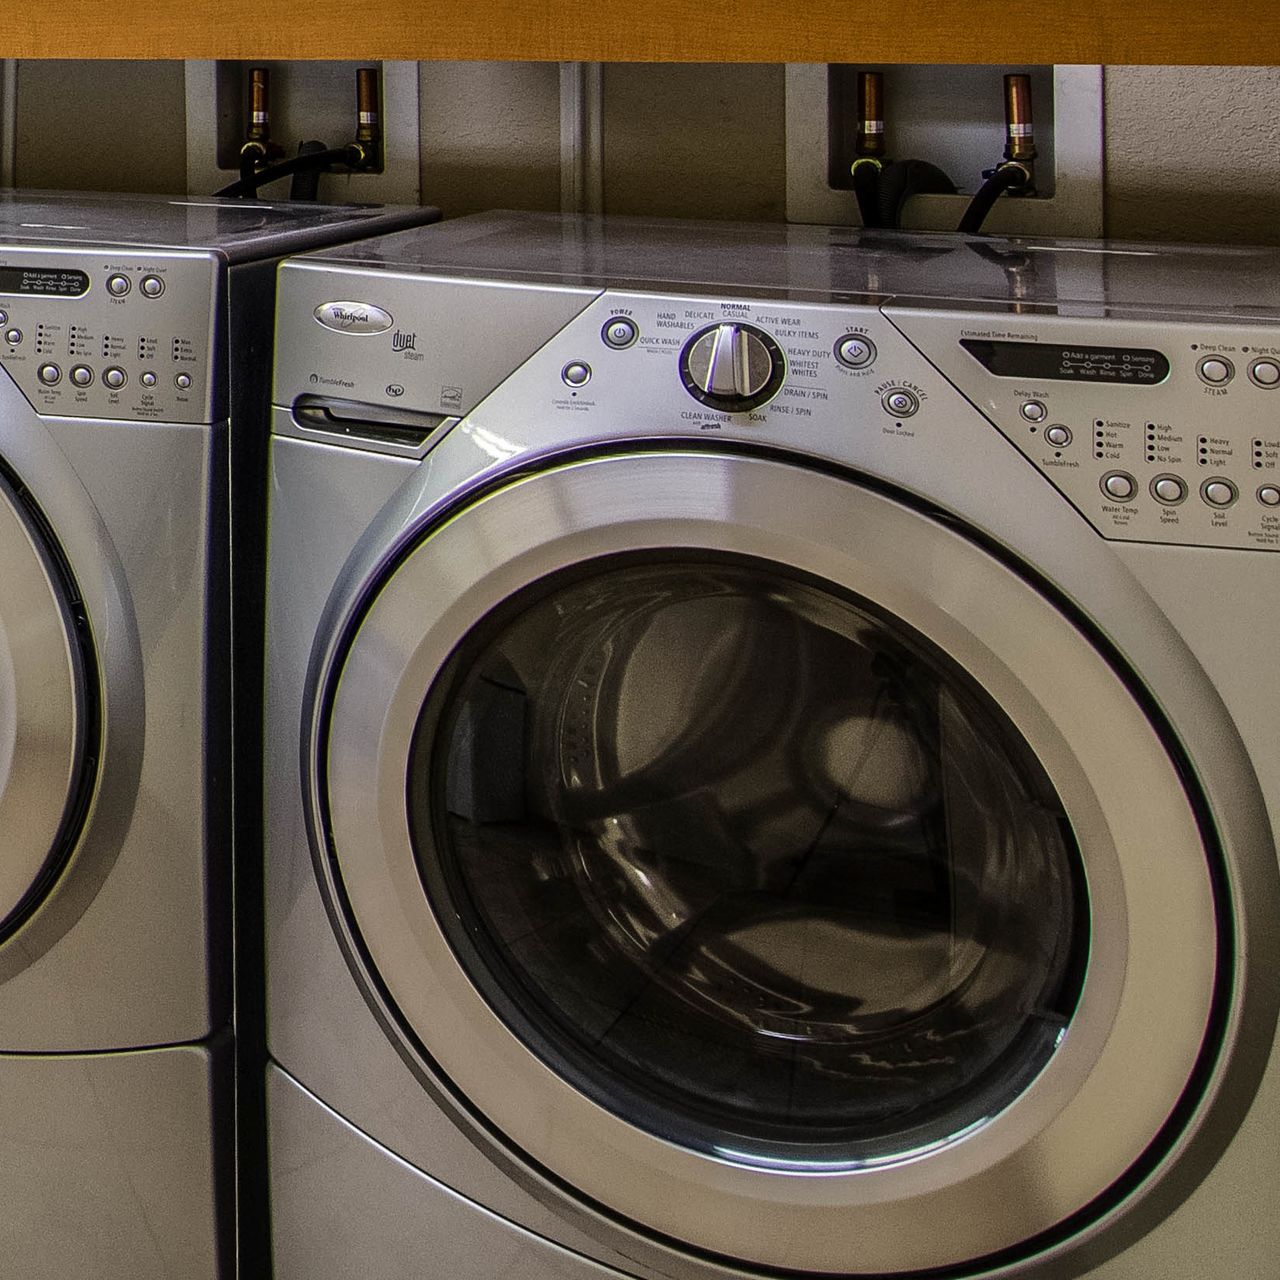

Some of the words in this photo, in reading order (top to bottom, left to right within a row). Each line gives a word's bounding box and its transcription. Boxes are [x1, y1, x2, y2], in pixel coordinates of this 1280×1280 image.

[721, 303, 751, 311] NORMAL
[657, 312, 676, 320] HAND
[685, 311, 714, 319] DELICATE
[723, 310, 748, 318] CASUAL
[656, 321, 695, 329] WASHABLES
[756, 316, 780, 324] ACTIVE
[781, 318, 801, 326] WEAR
[775, 330, 797, 338] BULKY
[798, 331, 819, 339] ITEMS
[846, 326, 869, 334] START
[961, 330, 990, 338] Estimated
[992, 331, 1006, 339] Time
[1007, 332, 1038, 341] Remaining
[788, 348, 811, 357] HEAVY
[812, 350, 831, 359] DUTY
[790, 360, 819, 368] WHITEST
[791, 369, 817, 378] WHITES
[784, 388, 806, 397] DRAIN
[812, 391, 828, 400] SPIN
[874, 381, 895, 396] PAUSE
[903, 381, 928, 401] CANCEL
[1014, 389, 1031, 398] Delay
[1033, 390, 1049, 398] Wash
[1204, 387, 1227, 396] STEAM
[770, 405, 789, 414] RINSE
[795, 407, 812, 416] SPIN
[681, 411, 703, 420] CLEAN
[704, 413, 732, 422] WASHER
[749, 413, 767, 422] SOAK
[1158, 424, 1172, 432] High
[1210, 438, 1229, 446] Heavy
[1210, 448, 1232, 456] Normal
[1210, 459, 1226, 467] Light
[1160, 516, 1179, 524] Speed
[1211, 520, 1228, 528] Level
[1262, 515, 1278, 523] Cycle
